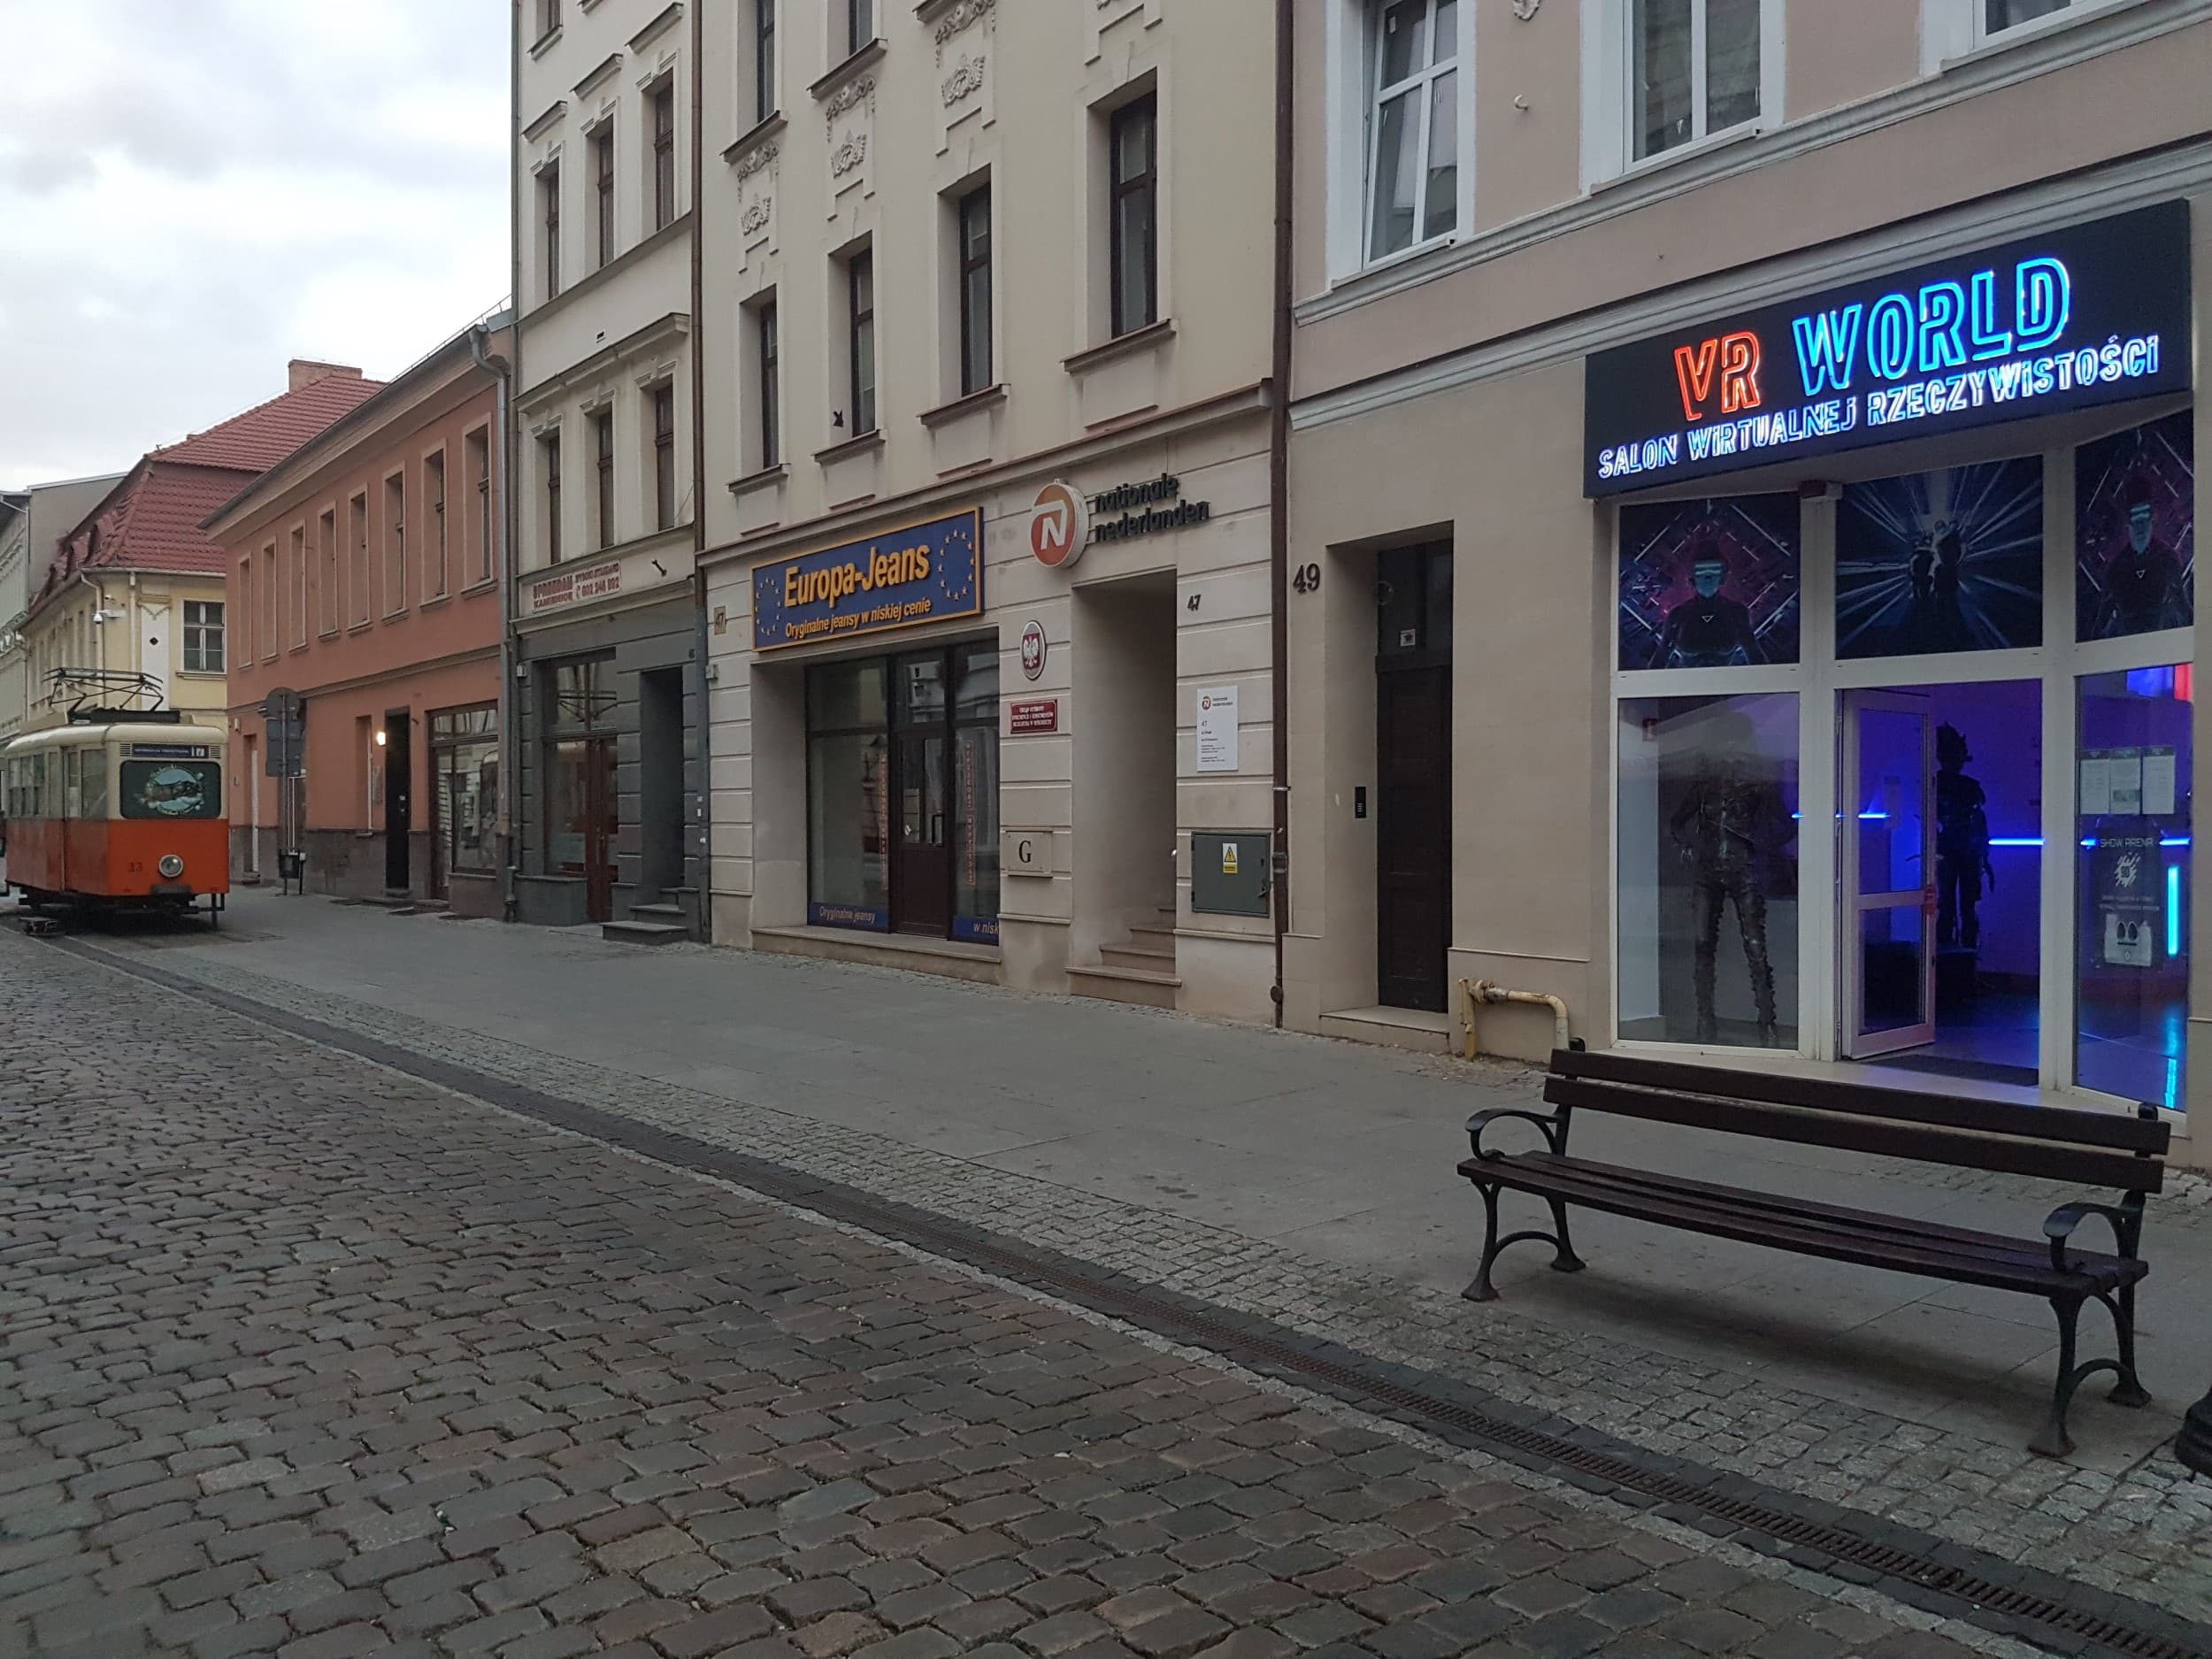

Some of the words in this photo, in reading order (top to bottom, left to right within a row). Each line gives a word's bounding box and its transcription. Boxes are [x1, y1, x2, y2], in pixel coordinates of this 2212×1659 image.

[1674, 331, 1761, 421] VR
[1791, 257, 2071, 396] WORLD
[1598, 434, 1678, 480] SALON
[1094, 472, 1180, 513] nationale
[1094, 499, 1210, 542] nederlanden
[784, 544, 931, 608] Europa-Jeans
[1293, 563, 1321, 595] 49
[785, 617, 829, 641] Oryginalne
[829, 611, 860, 632] jeansy
[861, 611, 870, 624] w
[871, 601, 902, 621] niskiej
[903, 596, 932, 615] cenie
[1187, 594, 1202, 612] 47
[1018, 840, 1032, 864] G
